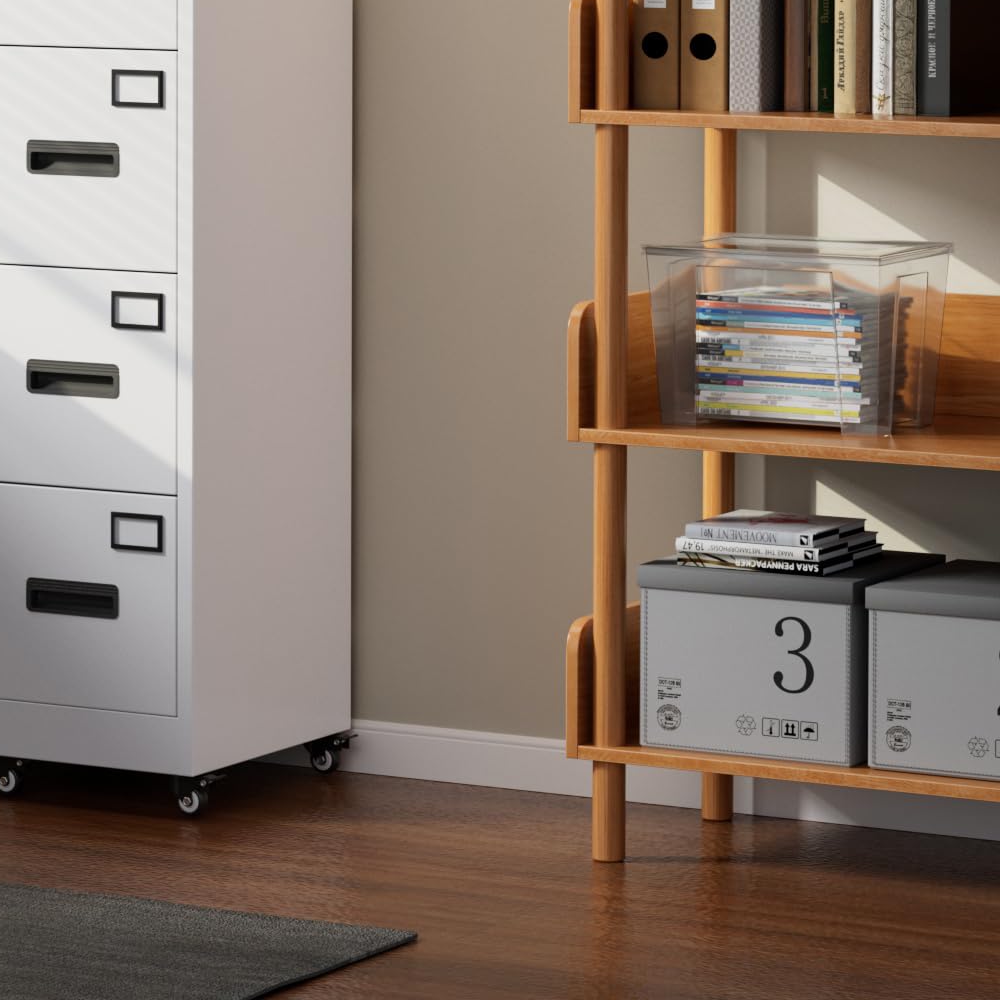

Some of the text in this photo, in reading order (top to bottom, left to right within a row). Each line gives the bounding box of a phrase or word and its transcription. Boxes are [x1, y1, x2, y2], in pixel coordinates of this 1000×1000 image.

[927, 42, 937, 78] КРАСНОЕ
[716, 527, 777, 544] MOOVEMENT
[735, 558, 819, 573] SARA PENNYPACKER
[773, 616, 815, 694] 3
